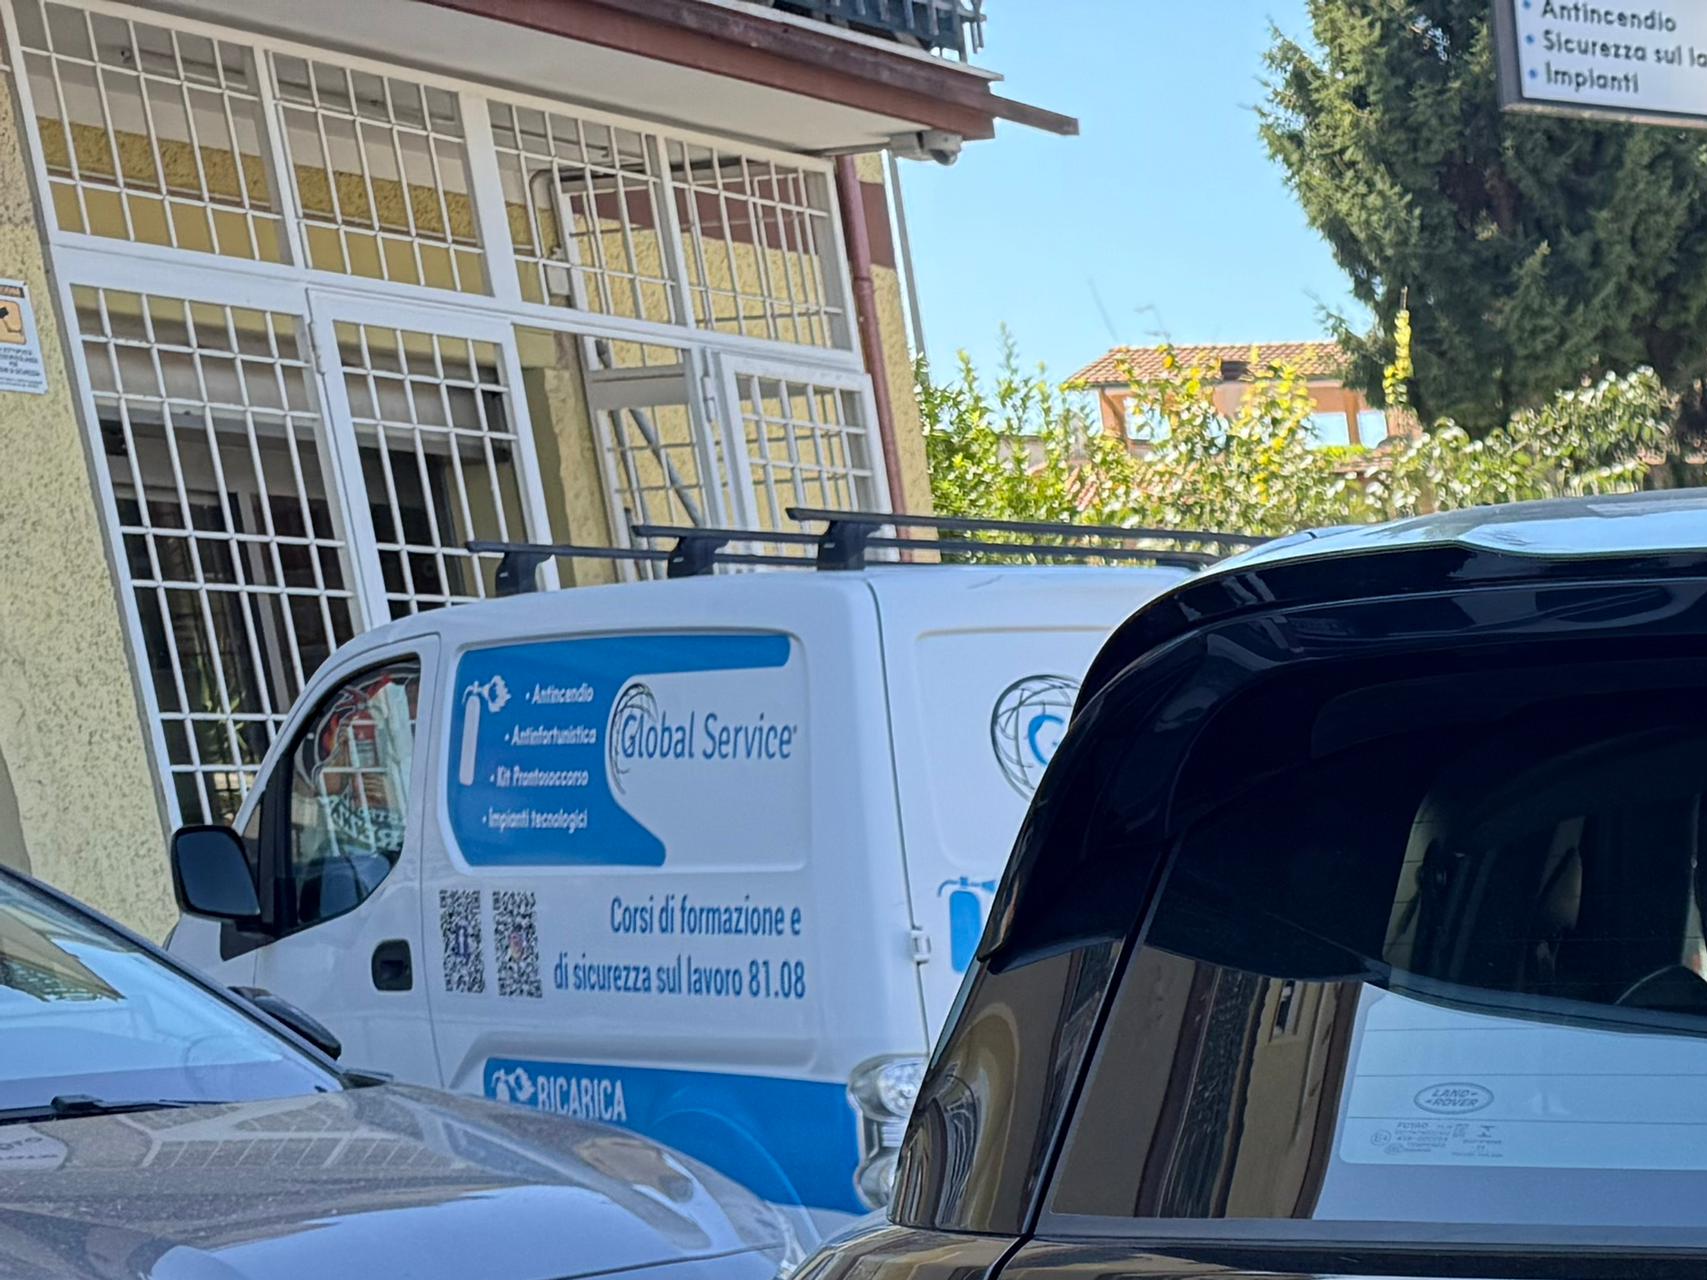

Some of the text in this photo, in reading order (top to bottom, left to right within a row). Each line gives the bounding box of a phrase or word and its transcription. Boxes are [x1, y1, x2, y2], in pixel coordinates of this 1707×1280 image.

[1541, 0, 1677, 32] Antincendio
[1543, 30, 1647, 62] Sicurezza
[1655, 44, 1683, 67] sul
[1545, 62, 1640, 93] Impianti
[532, 682, 594, 704] Antincendio
[511, 724, 597, 746] Antinfortunistica
[621, 710, 792, 760] Global Service
[496, 765, 511, 787] Kit
[488, 806, 588, 834] Impianti tecnologici
[610, 894, 802, 936] Corsi di formazione e
[553, 952, 806, 999] di sicurezza sul lavoro 81.08
[536, 1074, 627, 1123] RICARICA
